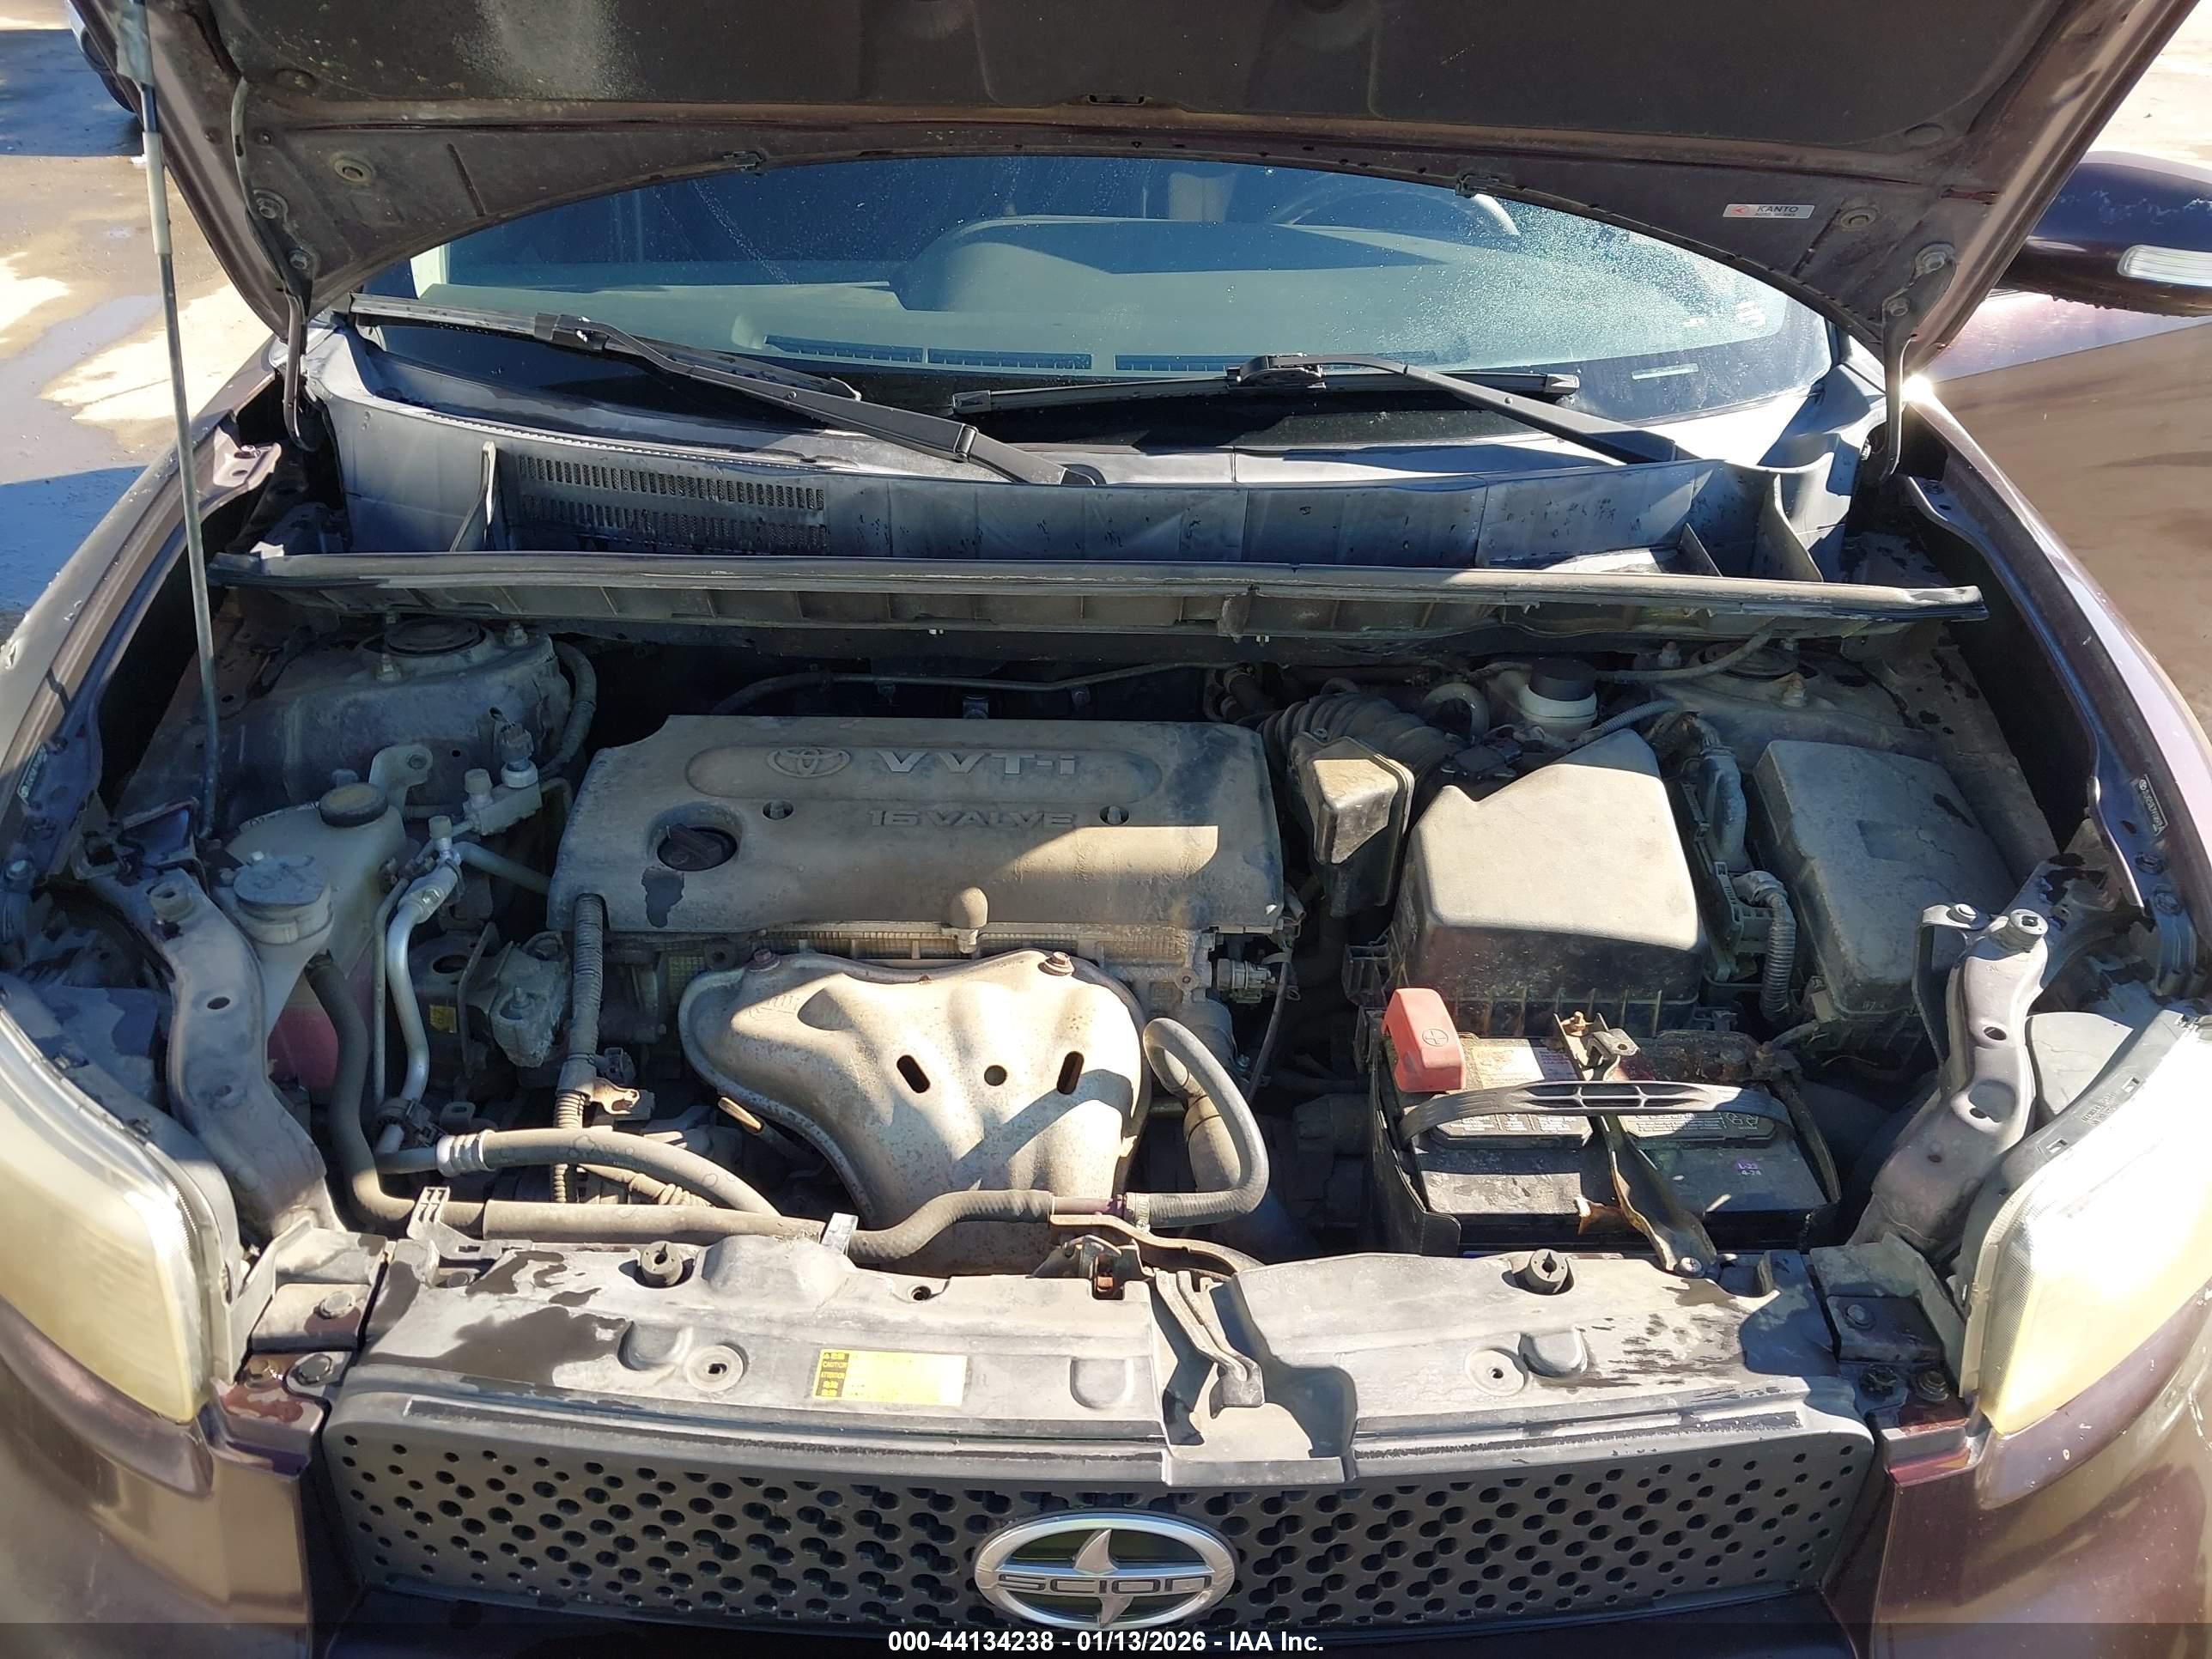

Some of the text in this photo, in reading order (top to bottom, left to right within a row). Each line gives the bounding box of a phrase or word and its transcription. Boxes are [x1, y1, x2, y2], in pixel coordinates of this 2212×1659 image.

[878, 750, 1076, 775] VVT-i
[869, 810, 1076, 827] 16 VALVE
[998, 1573, 1212, 1595] SCION
